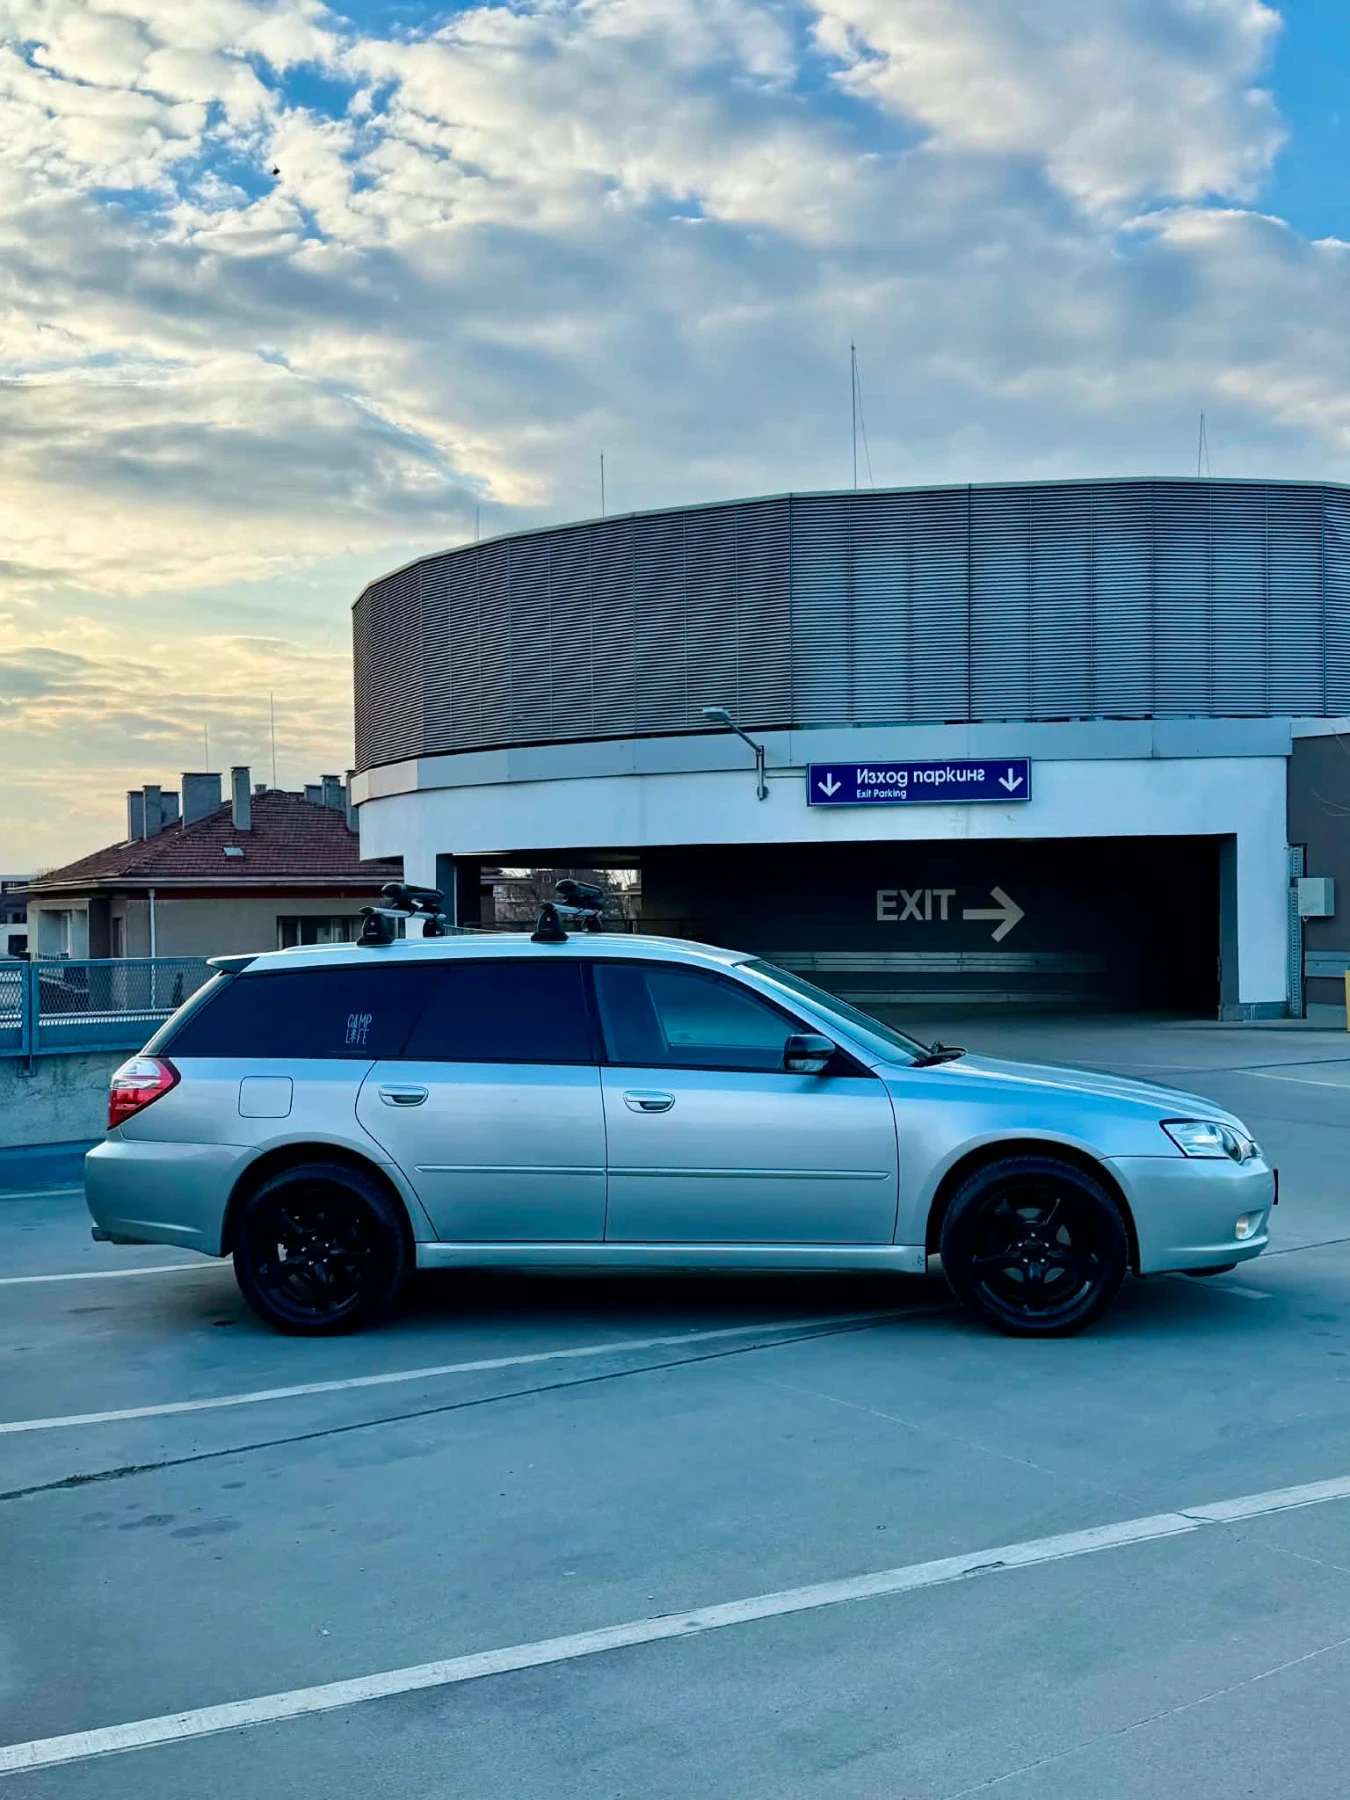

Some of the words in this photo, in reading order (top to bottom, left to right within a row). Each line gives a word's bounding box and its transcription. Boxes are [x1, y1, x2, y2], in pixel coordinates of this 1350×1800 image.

[857, 768, 908, 787] Изход
[913, 766, 985, 786] паркинг
[856, 789, 872, 799] Exit
[873, 788, 907, 800] Parking
[876, 889, 956, 921] EXIT
[347, 1013, 373, 1028] CAMP
